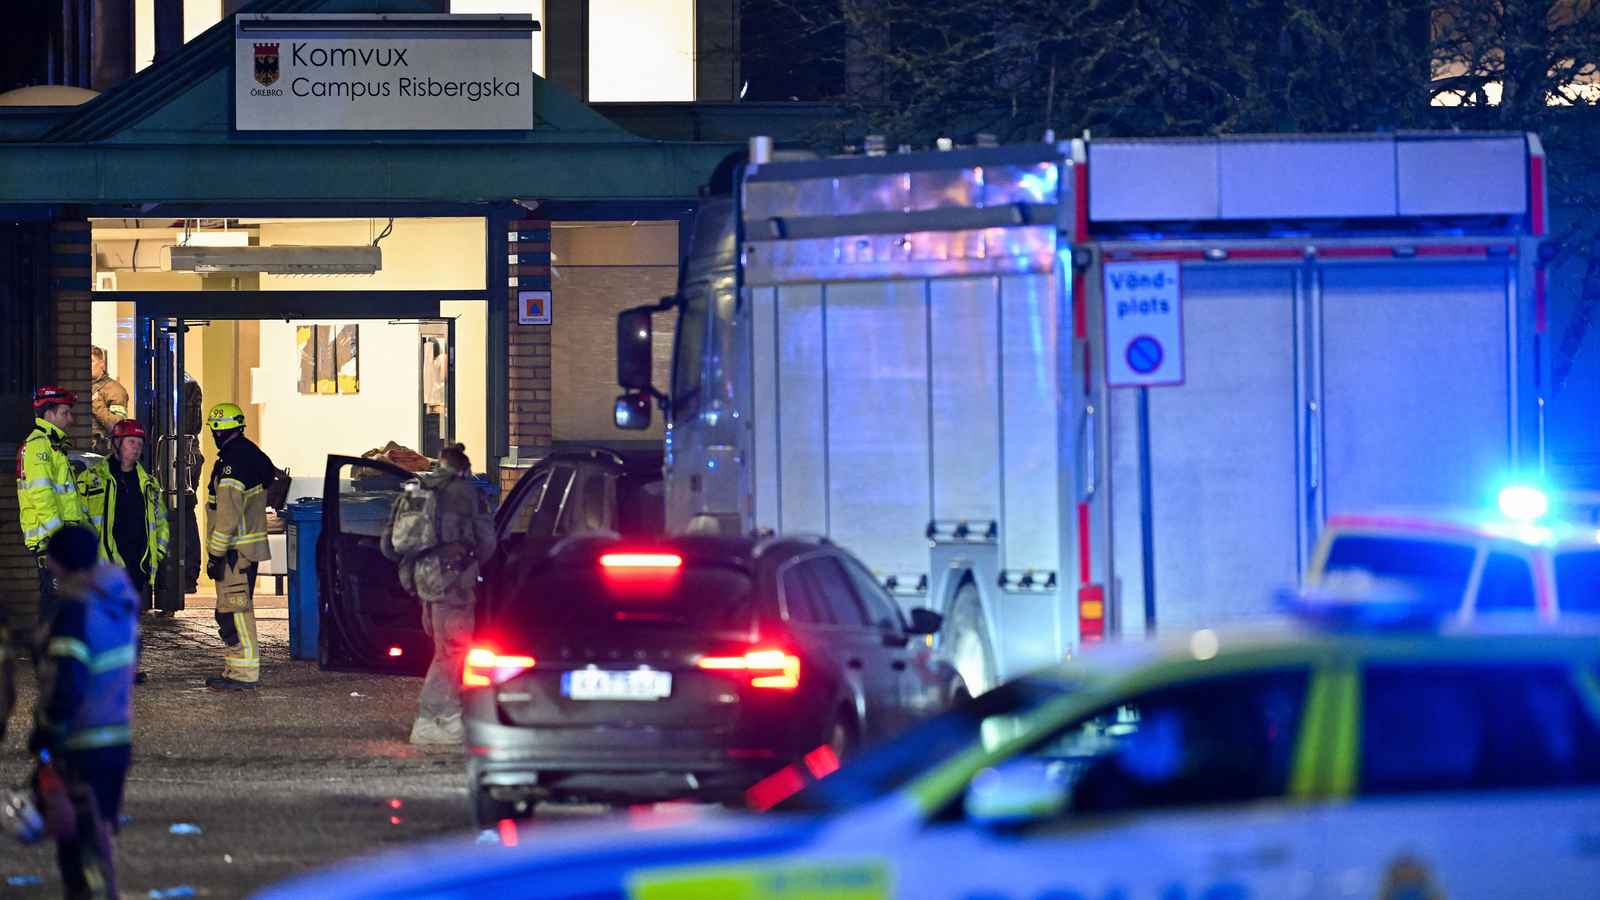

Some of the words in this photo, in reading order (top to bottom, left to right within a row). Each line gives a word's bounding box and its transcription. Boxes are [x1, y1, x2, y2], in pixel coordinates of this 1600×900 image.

[292, 42, 408, 66] Komvux
[291, 77, 391, 101] Campus
[399, 77, 520, 102] Risbergska
[1117, 296, 1170, 319] plats
[213, 409, 224, 418] 98
[229, 596, 244, 606] 98
